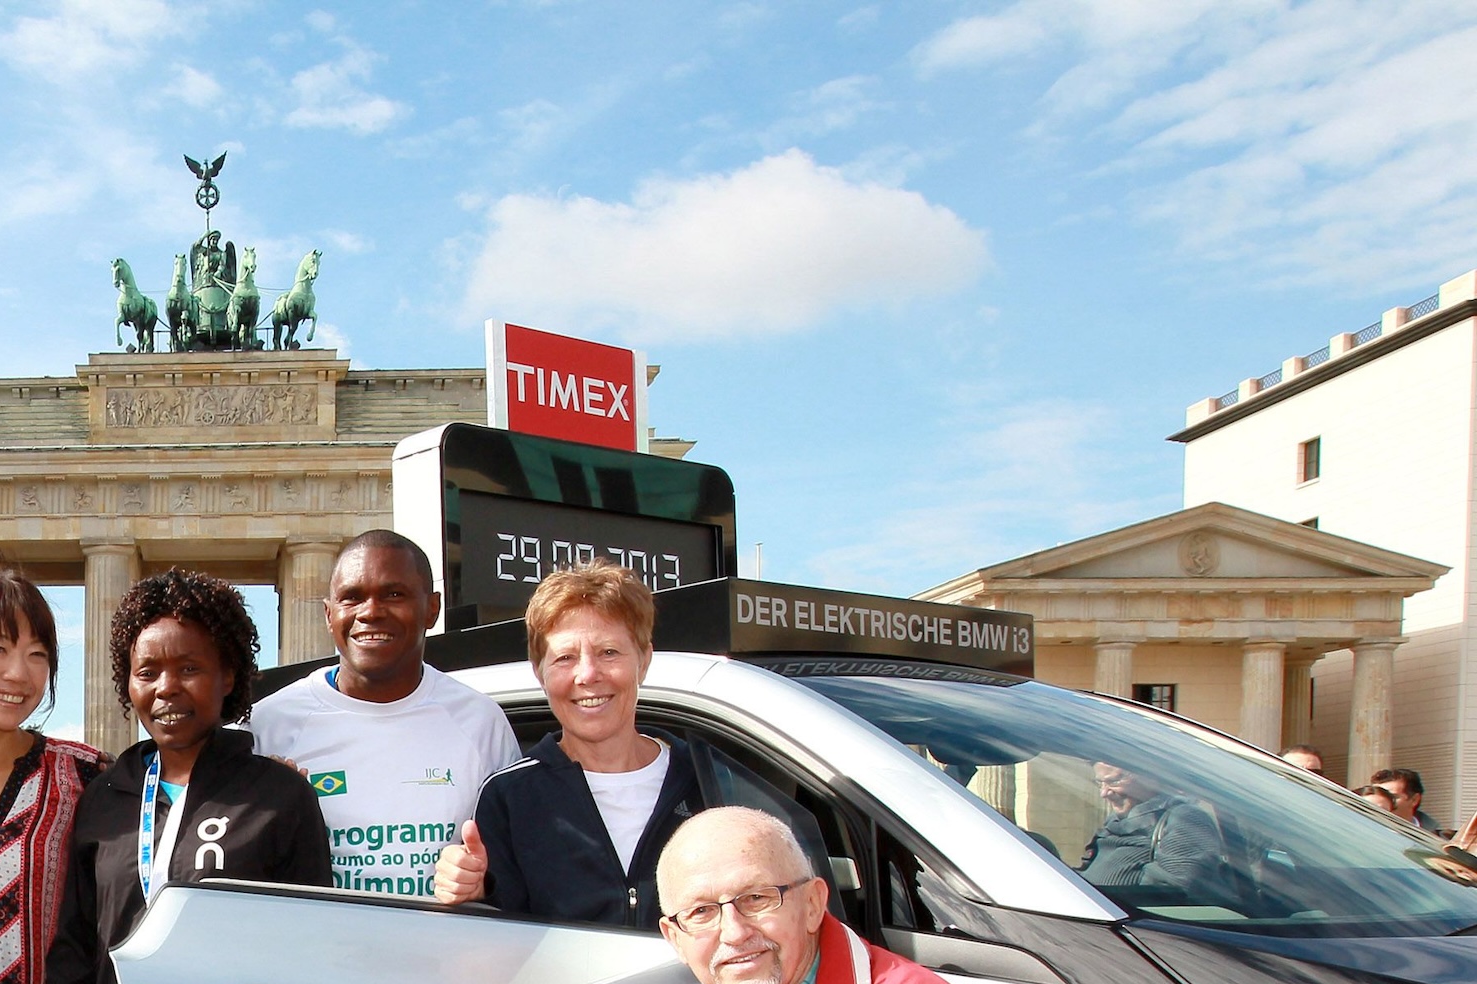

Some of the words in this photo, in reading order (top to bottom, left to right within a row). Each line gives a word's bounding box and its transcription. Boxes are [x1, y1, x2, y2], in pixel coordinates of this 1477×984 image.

[507, 361, 630, 422] TIMEX
[737, 593, 788, 628] DER
[794, 600, 952, 646] ELEKTRISCHE
[958, 620, 1008, 651] BMW
[1013, 626, 1030, 654] i3
[325, 821, 455, 851] rograma
[381, 853, 404, 865] ao
[410, 847, 443, 868] pód
